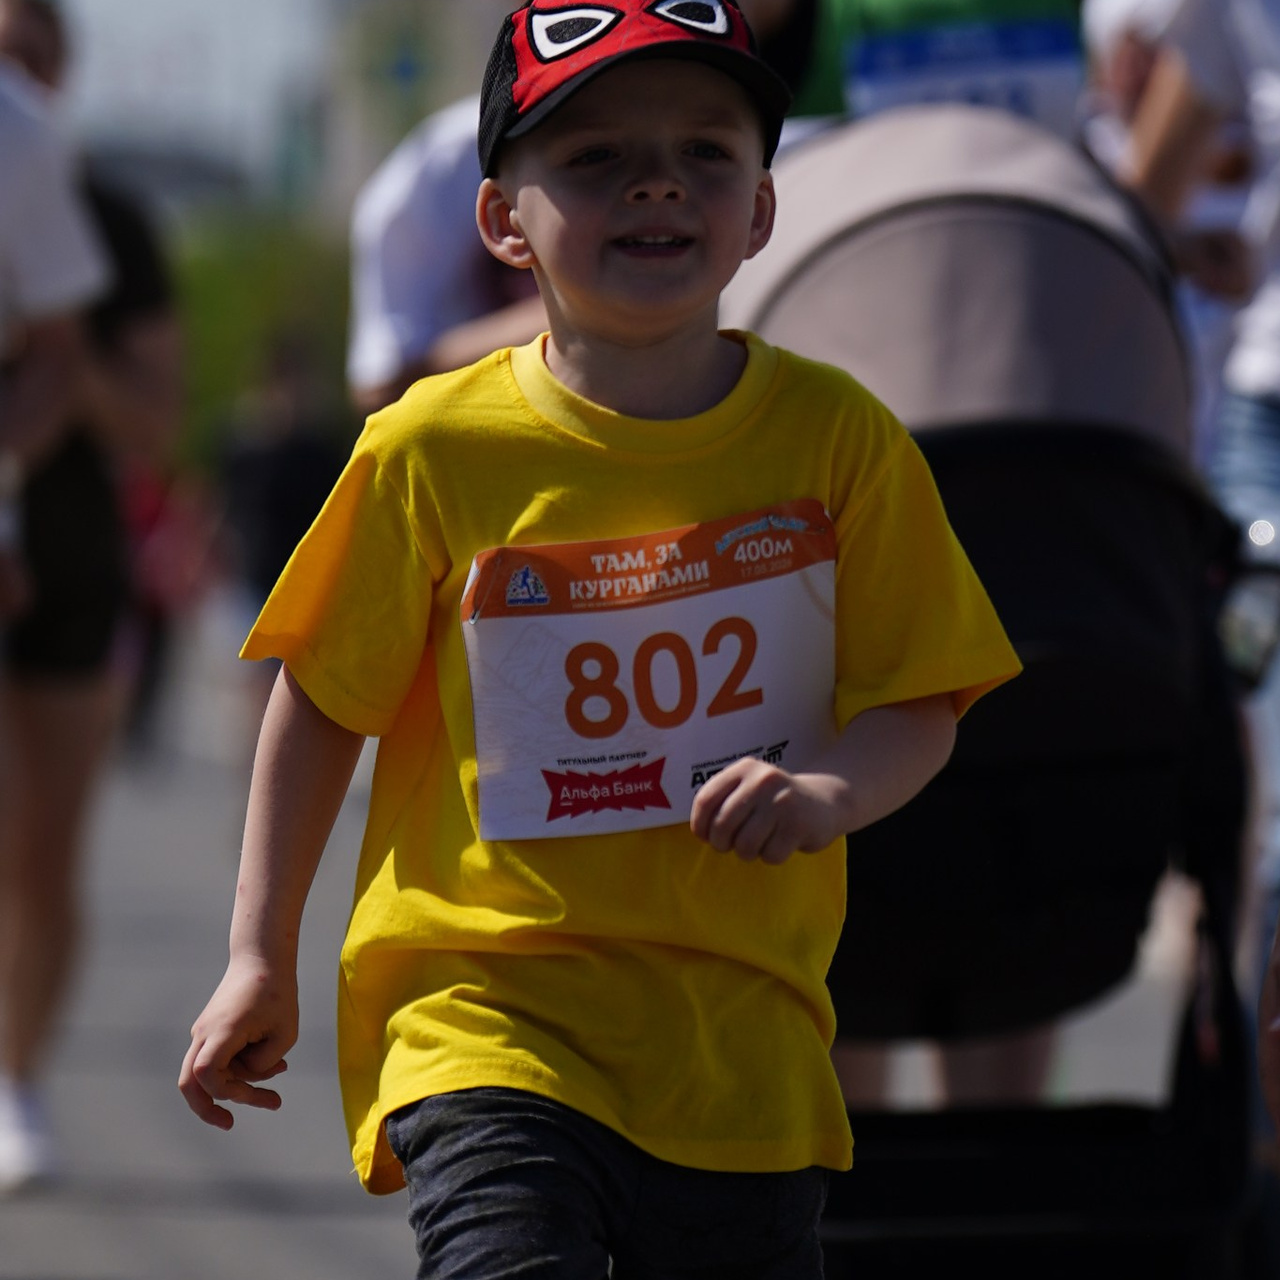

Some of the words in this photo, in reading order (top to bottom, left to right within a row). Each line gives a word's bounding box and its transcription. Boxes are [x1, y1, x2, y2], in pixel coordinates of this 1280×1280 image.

[590, 548, 652, 574] ТАМ,
[655, 542, 683, 565] ЗА
[569, 560, 710, 601] КУРГАНАМИ
[564, 616, 763, 739] 802
[560, 783, 611, 803] Альфа
[612, 780, 653, 796] Банк
